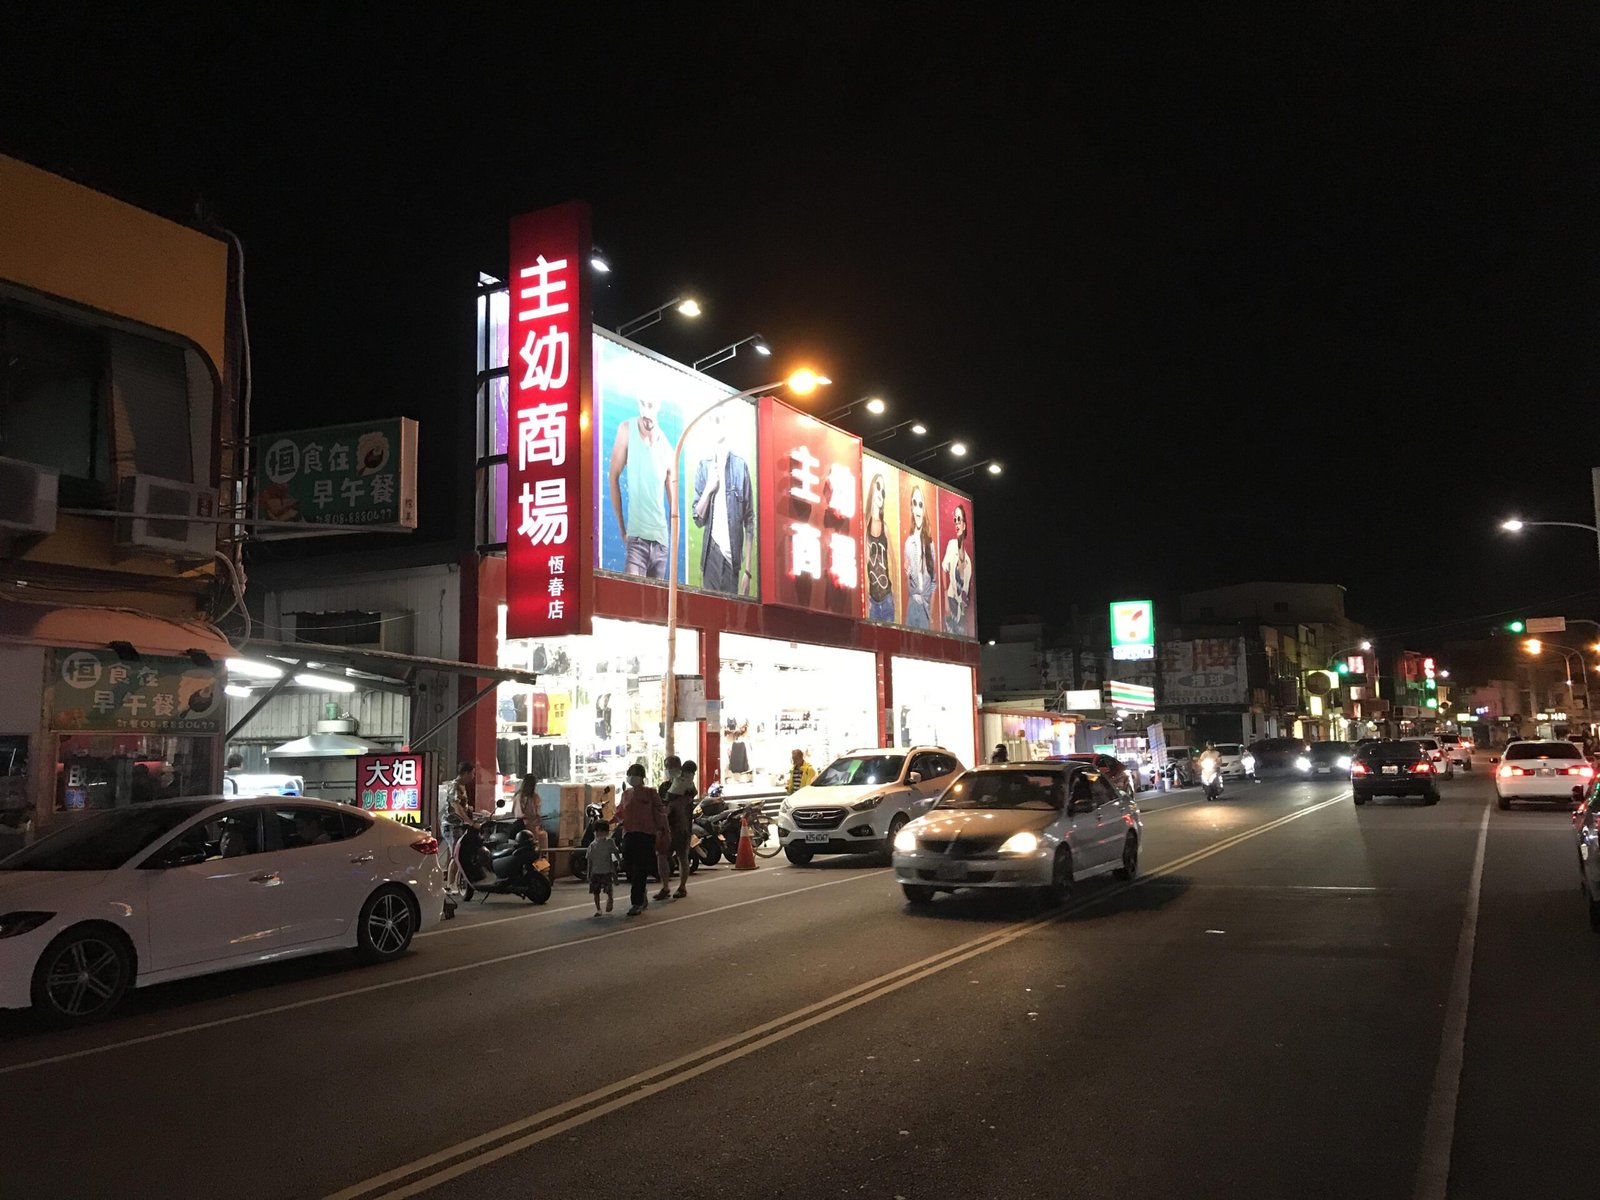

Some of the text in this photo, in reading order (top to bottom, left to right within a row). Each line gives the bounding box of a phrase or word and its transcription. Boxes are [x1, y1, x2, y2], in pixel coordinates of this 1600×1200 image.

[517, 254, 569, 546] 主幼商場
[313, 474, 394, 509] 早午餐
[548, 555, 566, 620] 恆春店
[93, 690, 175, 717] 早午餐
[365, 759, 417, 787] 大姐
[362, 789, 388, 809] 炒飯
